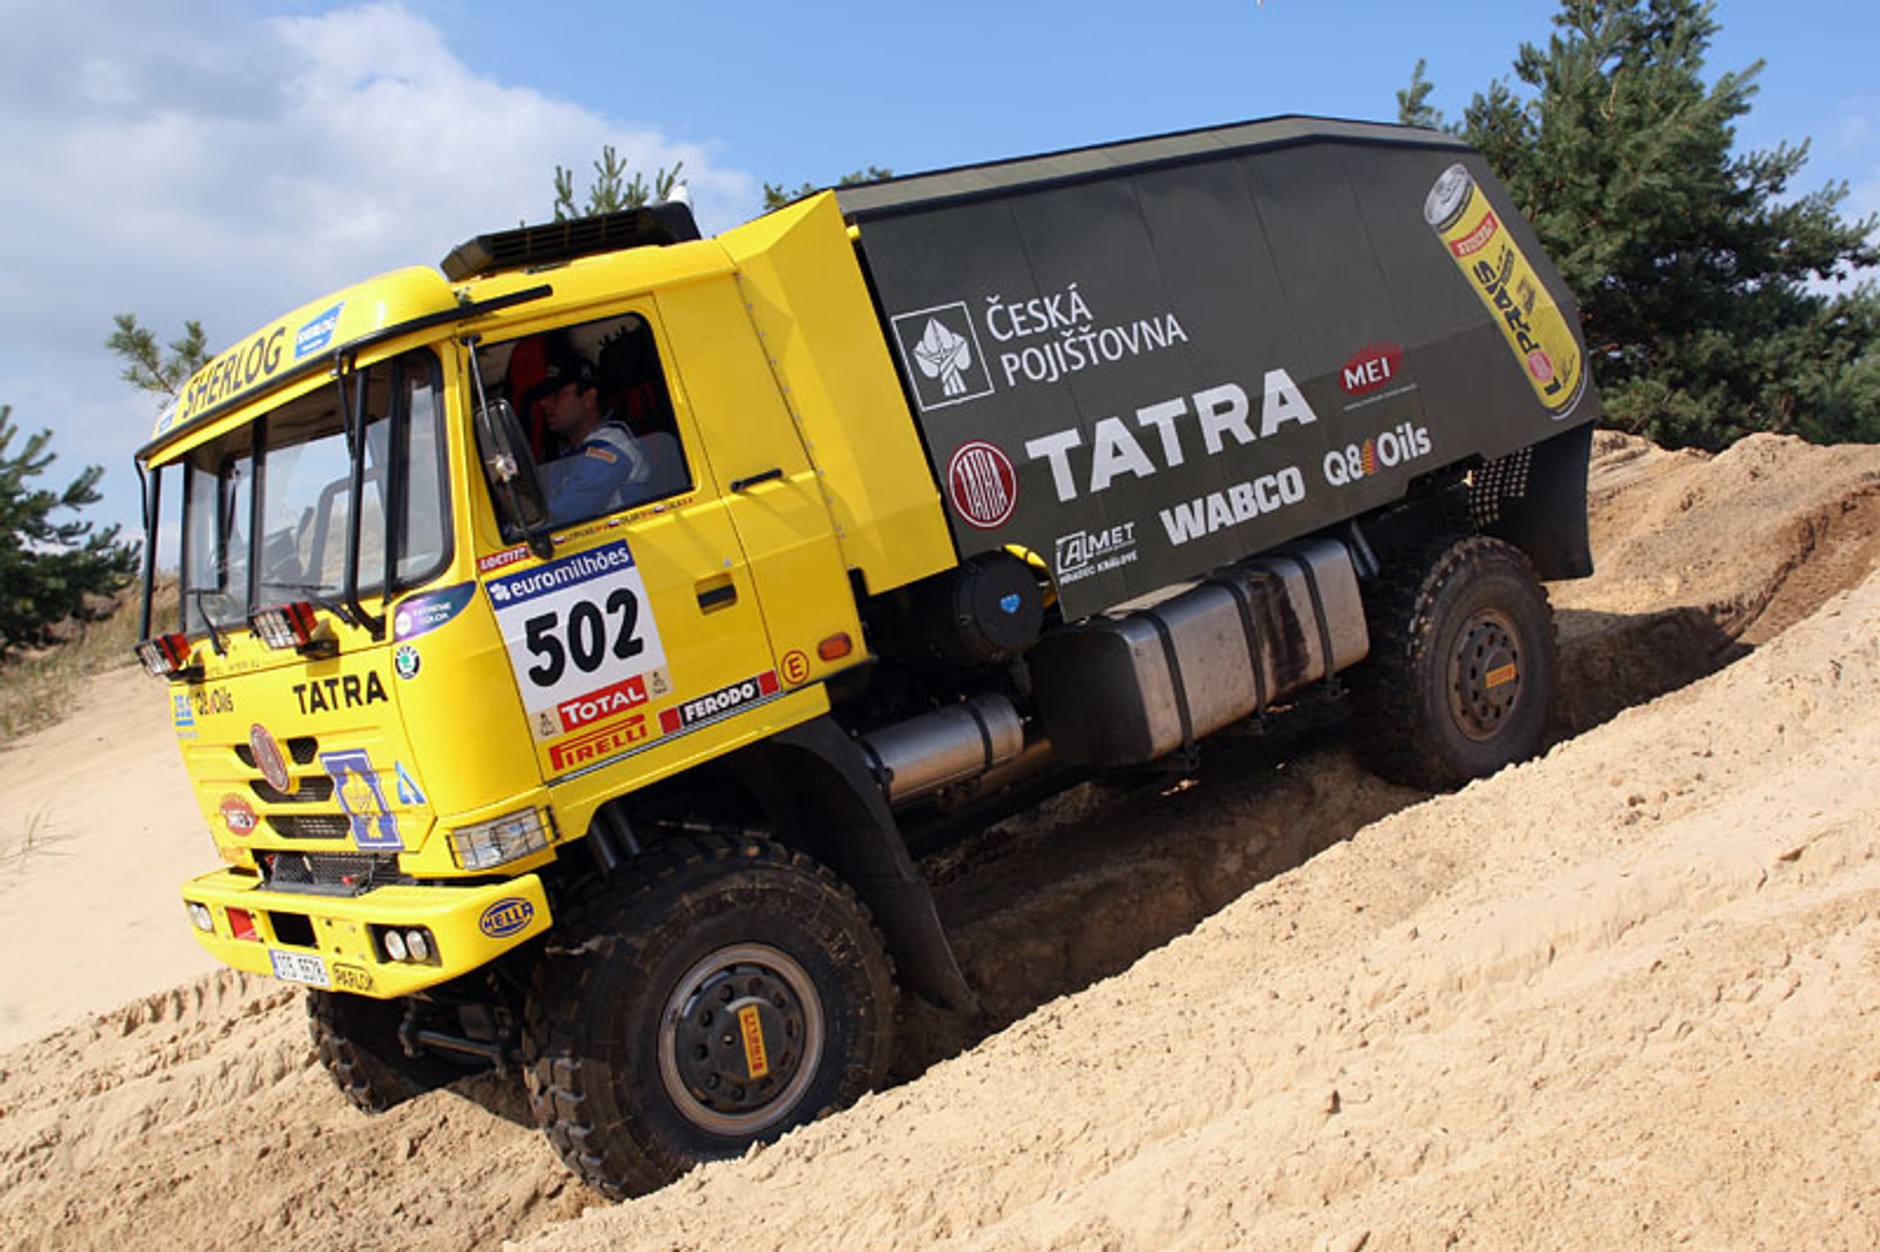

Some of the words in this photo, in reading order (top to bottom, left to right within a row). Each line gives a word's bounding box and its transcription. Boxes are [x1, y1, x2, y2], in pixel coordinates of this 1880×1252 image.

[986, 282, 1093, 342] ČESKÁ
[182, 326, 286, 419] SHERLOG
[1000, 313, 1189, 387] POJIŠŤOVNA
[1343, 356, 1391, 390] MEI
[1025, 368, 1317, 503] TATRA
[1323, 443, 1364, 487] Q8
[1376, 421, 1432, 467] Oils
[1159, 465, 1306, 547] WABCO
[510, 546, 630, 599] euromilhões
[525, 587, 644, 688] 502
[292, 670, 389, 715] TATRA
[561, 686, 645, 724] TOTAL
[683, 683, 755, 722] FERODO
[548, 713, 648, 772] PIRELLI
[483, 901, 535, 929] HELLA
